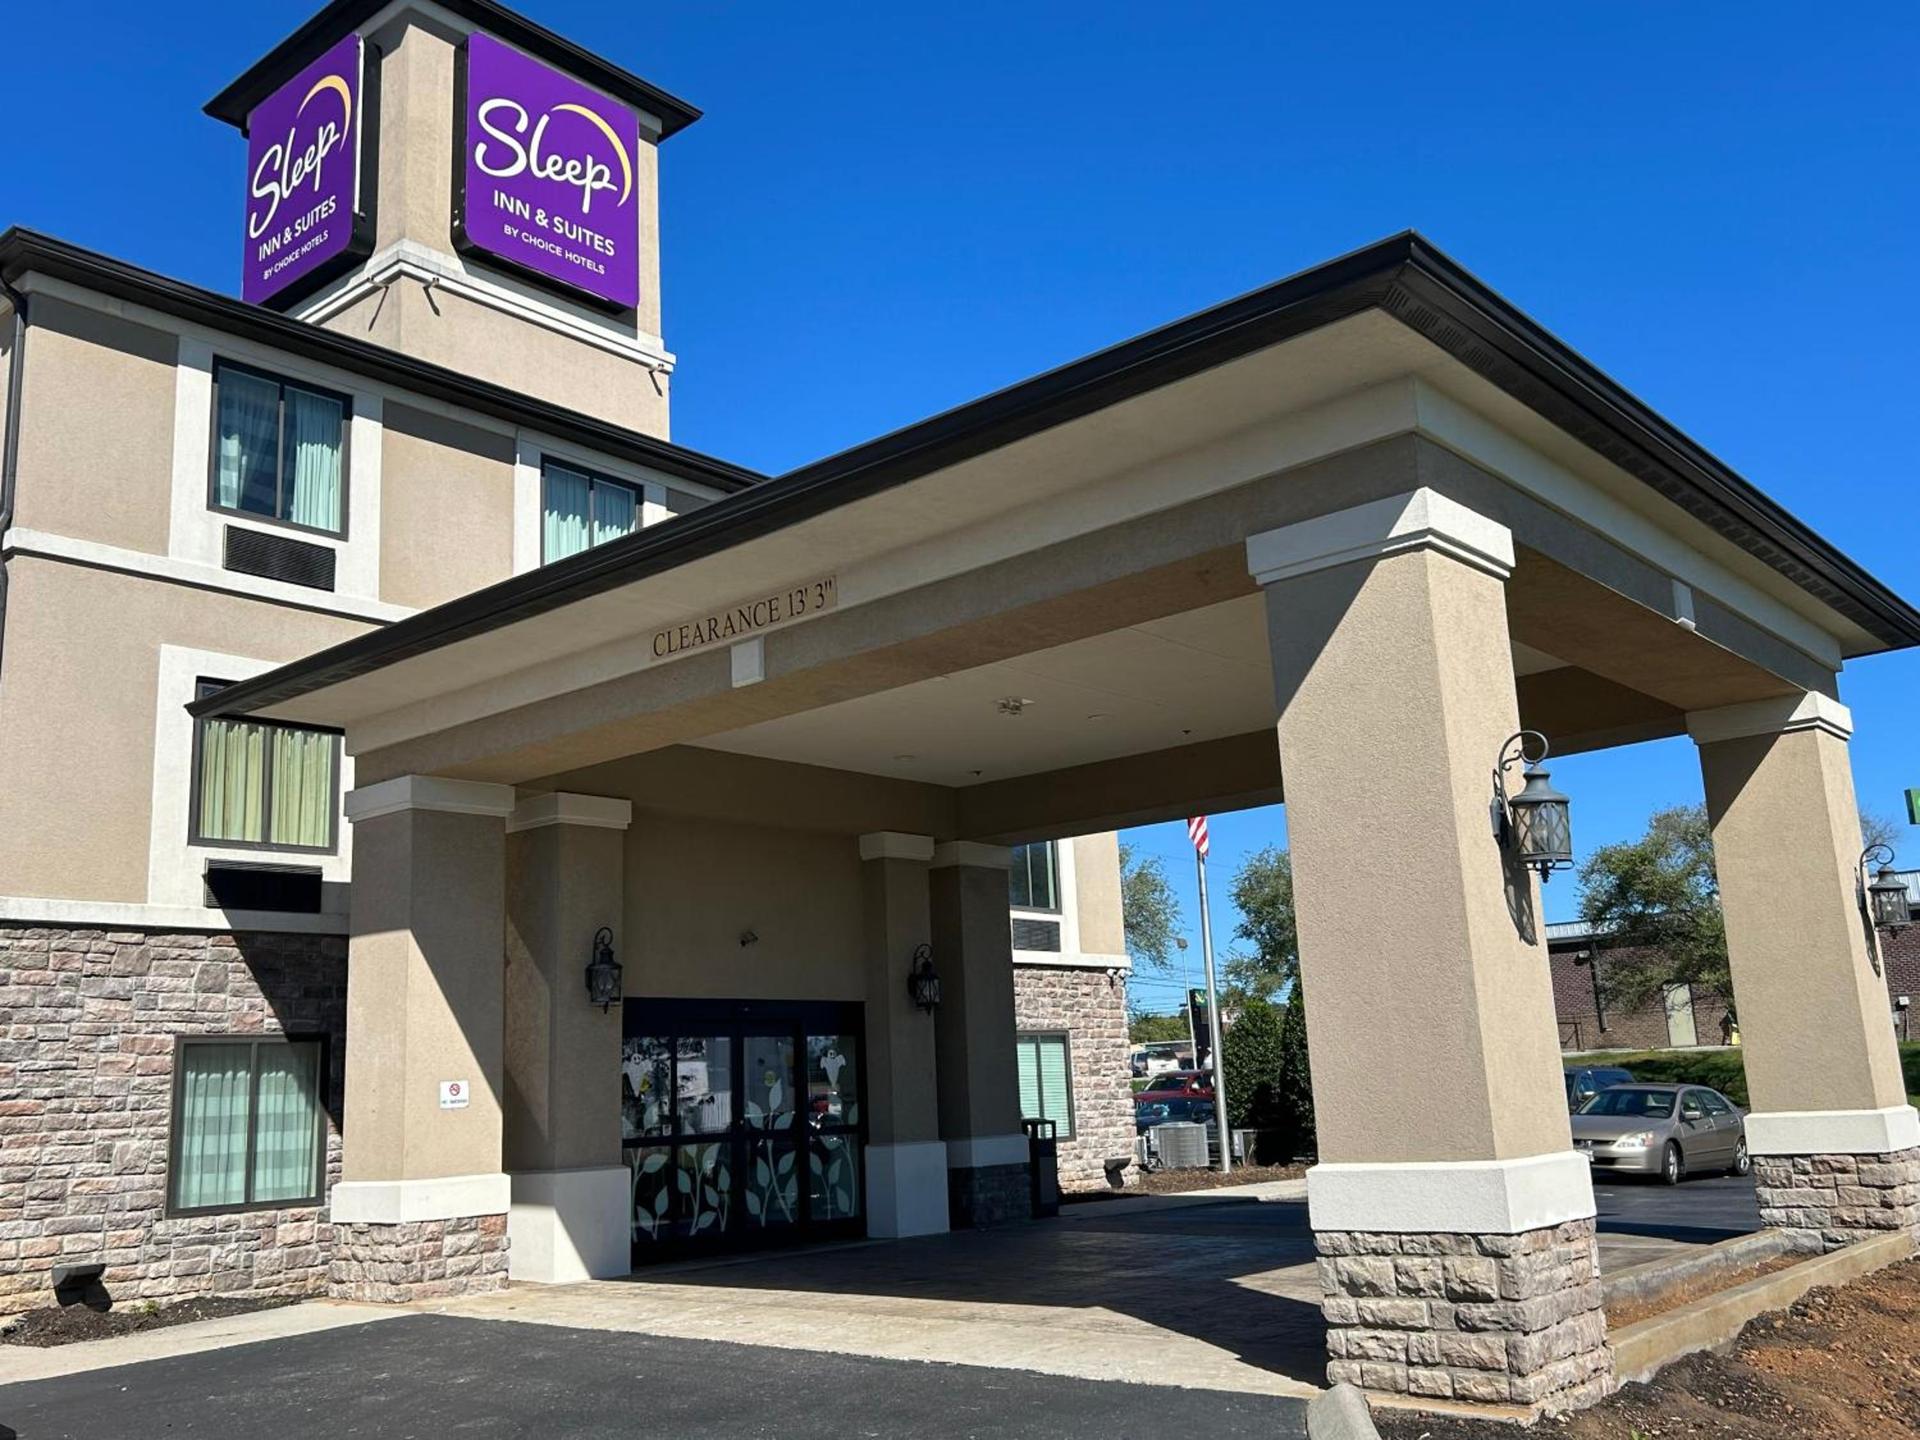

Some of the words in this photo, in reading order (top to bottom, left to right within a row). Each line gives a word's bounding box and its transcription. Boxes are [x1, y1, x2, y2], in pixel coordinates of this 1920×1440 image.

[249, 121, 340, 239] Sleep
[474, 98, 618, 214] Sleep
[258, 233, 281, 262] INN
[283, 226, 293, 245] &
[294, 195, 337, 238] SUITES
[263, 265, 274, 280] BY
[274, 249, 301, 272] CHOICE
[300, 229, 329, 256] HOTELS
[494, 190, 530, 220] INN
[534, 208, 549, 229] &
[553, 216, 615, 257] SUITES
[503, 223, 519, 238] BY
[521, 231, 563, 257] CHOICE
[564, 249, 606, 275] HOTELS
[653, 597, 781, 657] CLEARANCE
[788, 588, 809, 617] 13'
[815, 579, 833, 609] 3"
